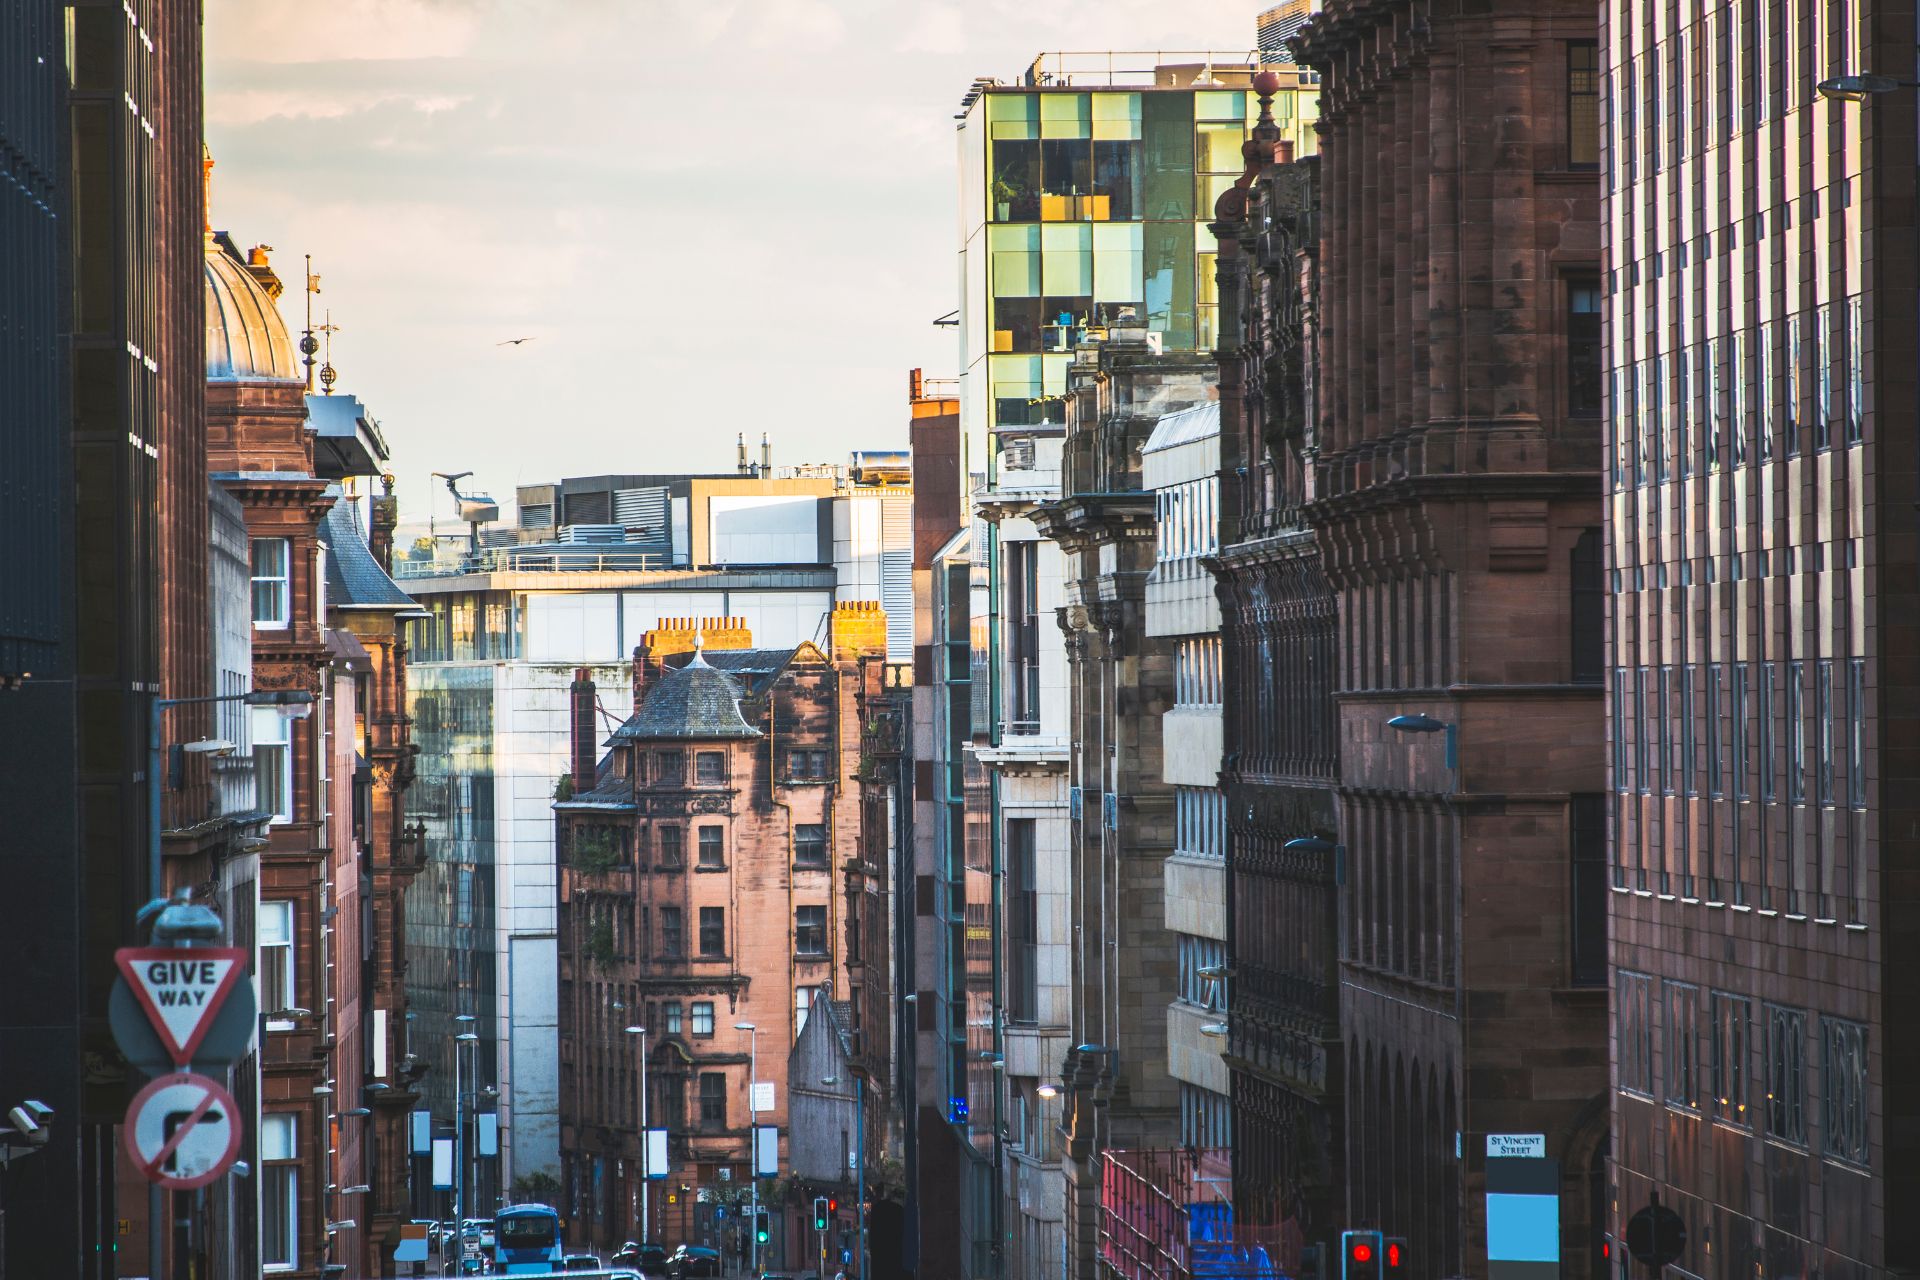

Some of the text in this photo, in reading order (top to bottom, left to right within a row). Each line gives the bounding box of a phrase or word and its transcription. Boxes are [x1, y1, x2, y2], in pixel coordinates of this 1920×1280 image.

[148, 962, 215, 985] GIVE
[158, 991, 205, 1006] WAY
[1503, 1136, 1540, 1145] VINCENT
[1500, 1145, 1531, 1154] STREET
